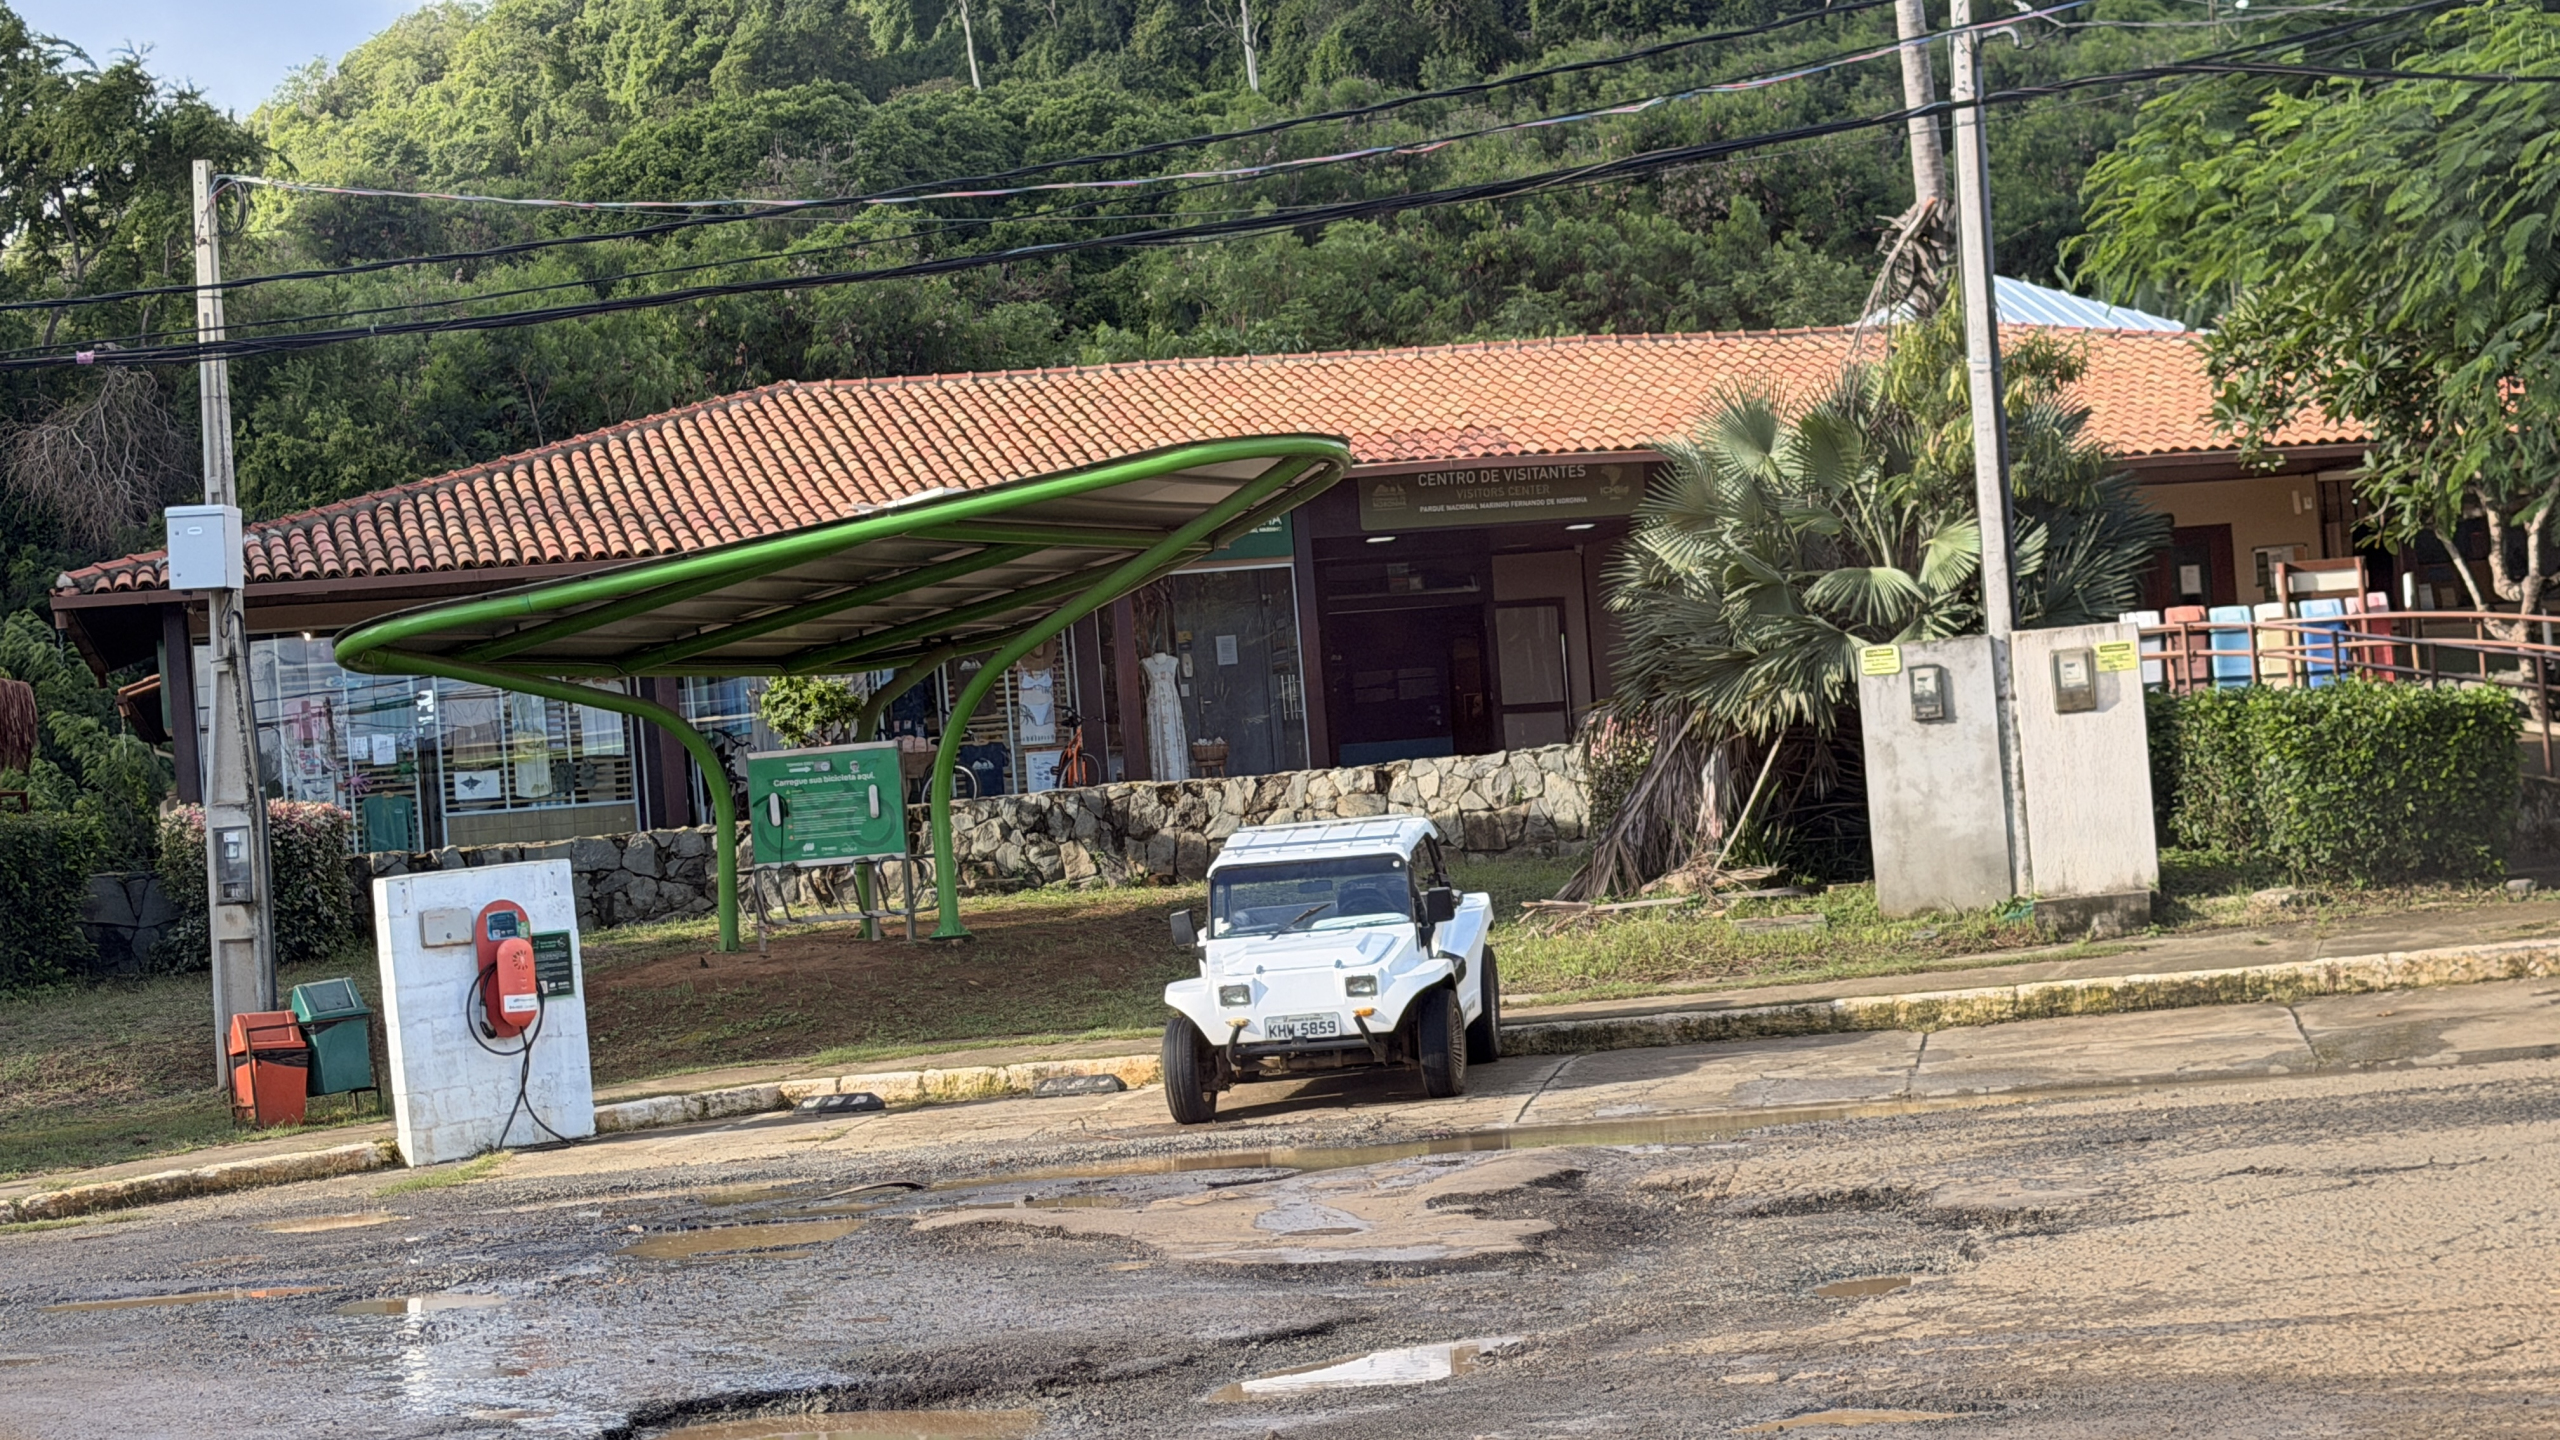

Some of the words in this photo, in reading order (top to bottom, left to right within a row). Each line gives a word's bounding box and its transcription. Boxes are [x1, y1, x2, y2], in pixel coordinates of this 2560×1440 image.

[1418, 470, 1476, 487] CENTRO
[1480, 469, 1500, 483] DE
[1503, 464, 1587, 482] VISITANTES
[1456, 486, 1505, 500] VISITORS
[1508, 484, 1550, 496] CENTER
[1420, 505, 1445, 513] PARQUE
[1446, 502, 1479, 512] NACIONAL
[1479, 501, 1510, 510] MARINHO
[1511, 498, 1546, 508] FERNANDO
[1546, 498, 1555, 506] DE
[1556, 496, 1588, 505] NORONHA
[773, 778, 808, 787] Carregue
[823, 773, 856, 783] bicicleta
[1301, 1021, 1336, 1036] 5859
